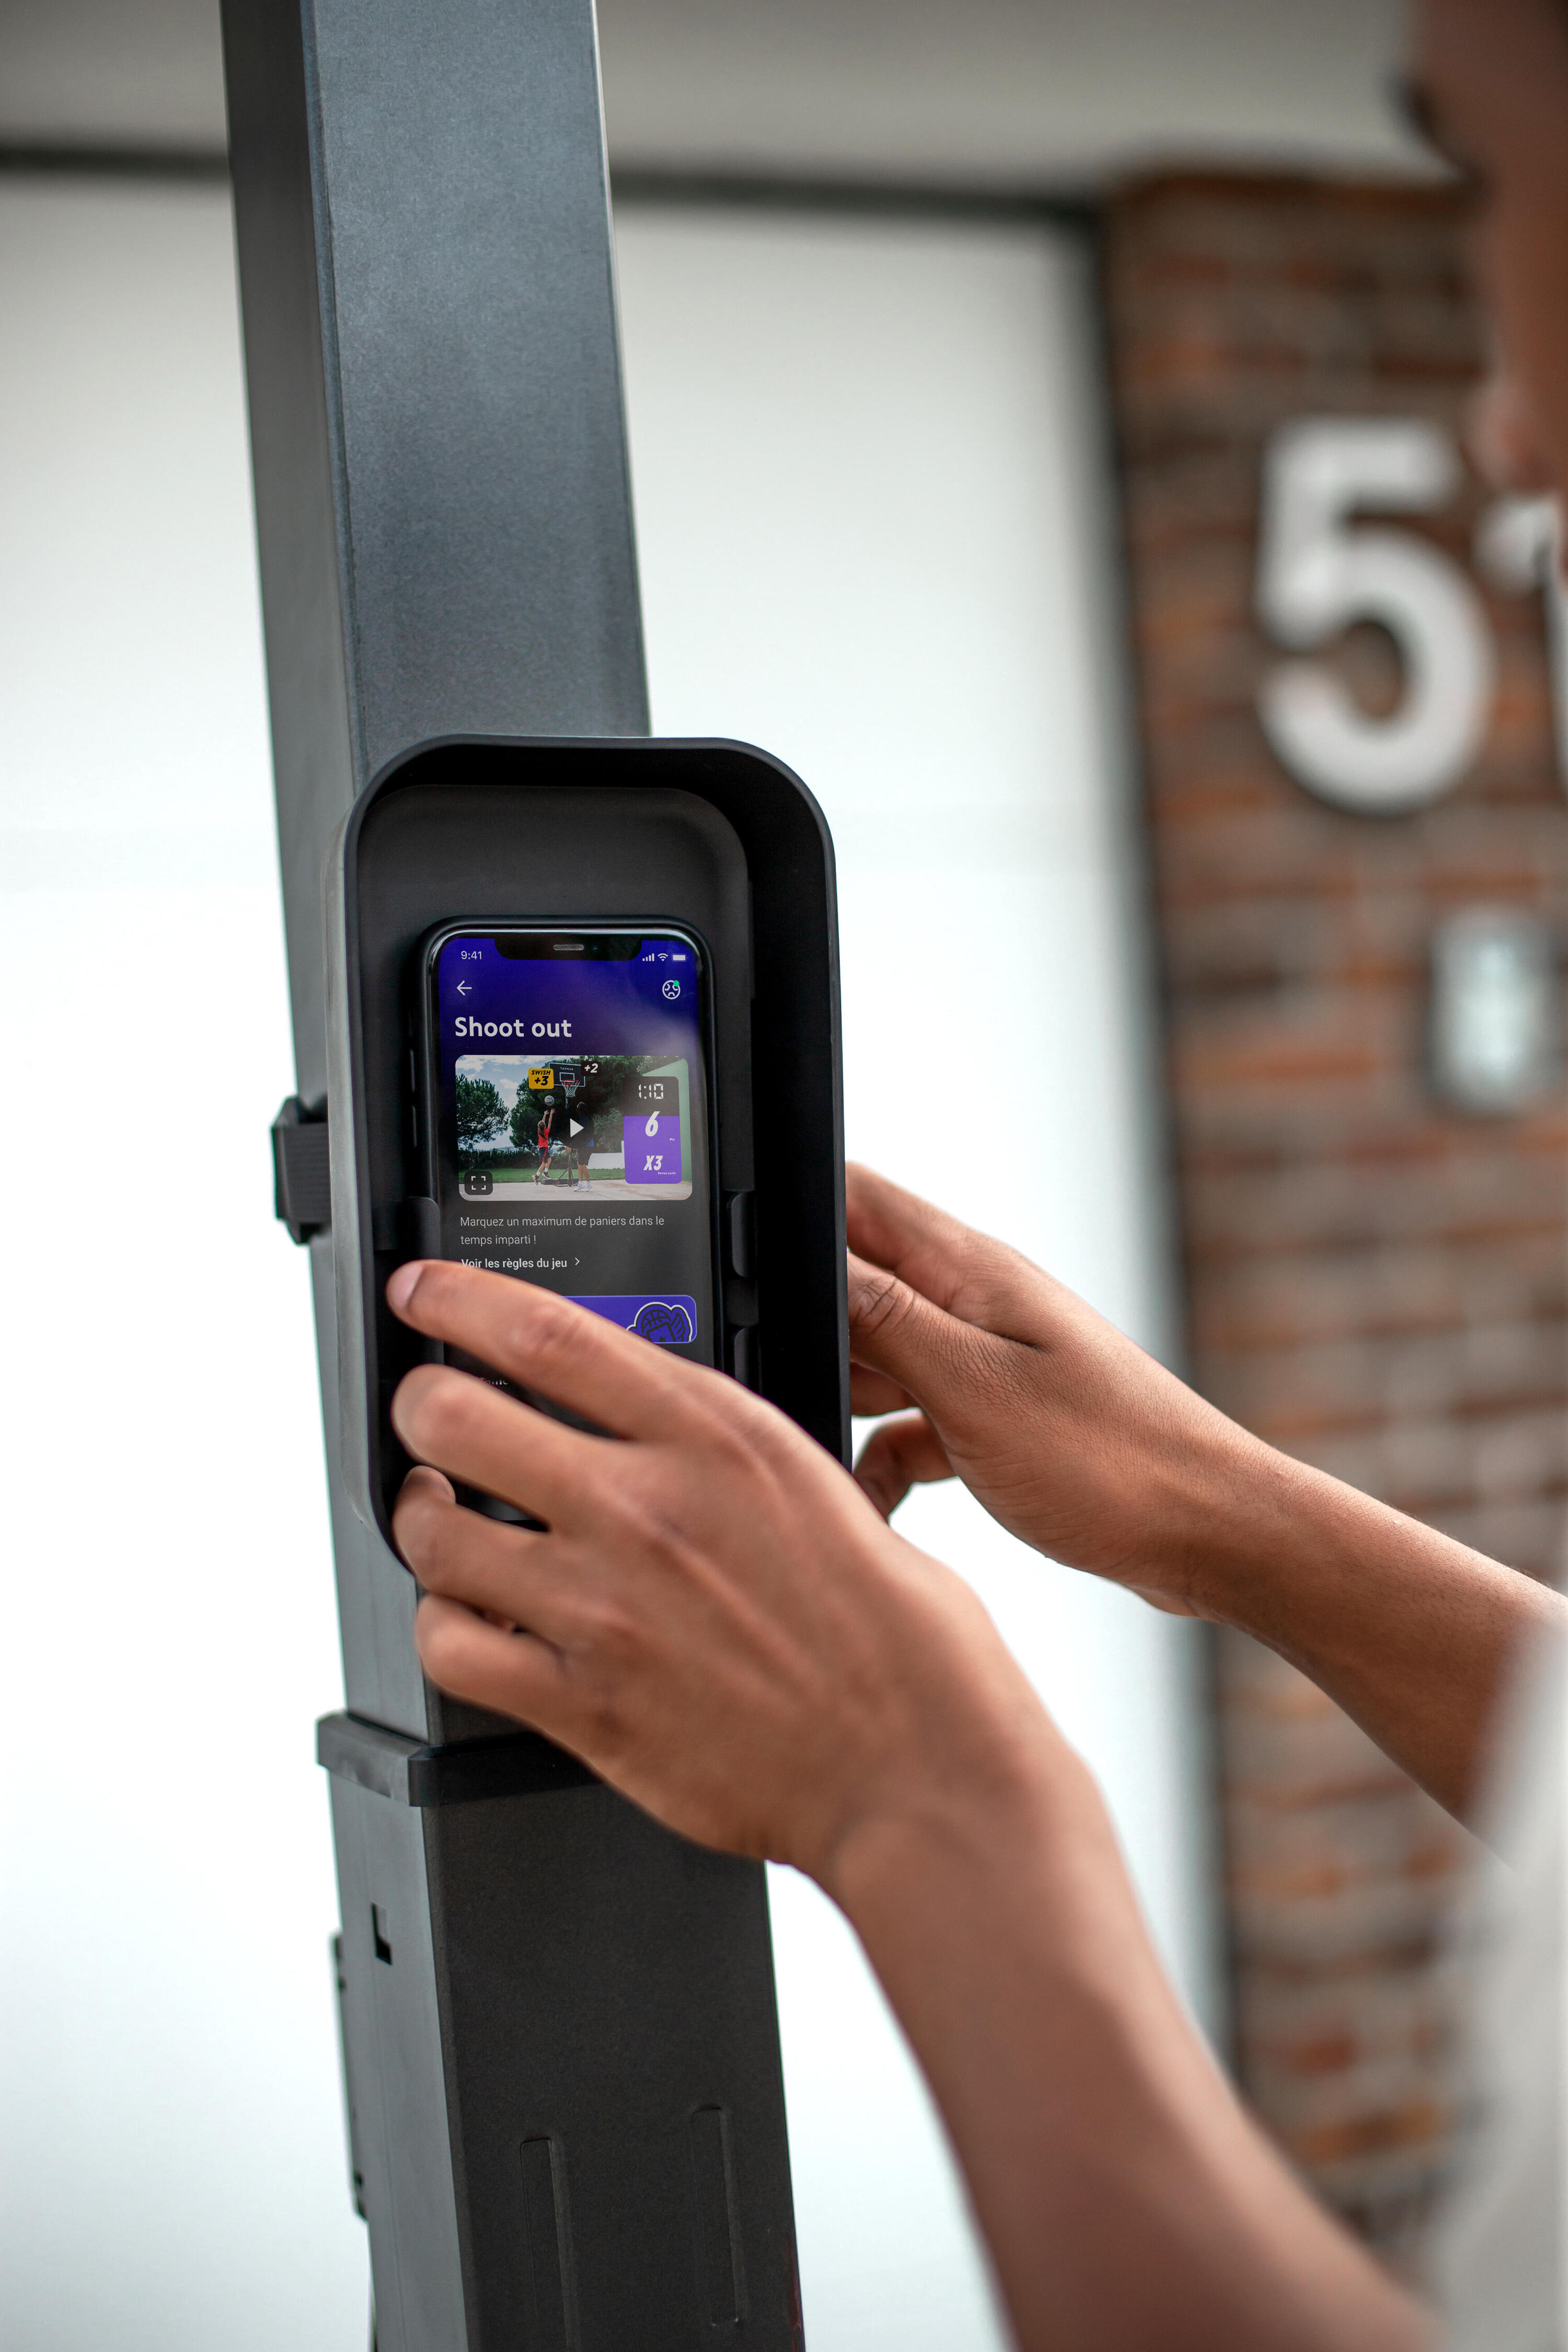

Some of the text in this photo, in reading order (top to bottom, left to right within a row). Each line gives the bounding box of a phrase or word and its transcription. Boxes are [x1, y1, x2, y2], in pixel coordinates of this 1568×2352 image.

[460, 950, 482, 960] 9:41
[455, 1016, 572, 1037] Shoot out
[584, 1063, 598, 1073] +2
[534, 1076, 549, 1086] +3
[638, 1083, 664, 1099] 1:10
[645, 1111, 660, 1137] 6
[643, 1155, 663, 1171] X3
[460, 1217, 504, 1228] Marquez
[523, 1217, 571, 1226] maximum
[575, 1216, 587, 1226] de
[590, 1216, 626, 1228] paniers
[629, 1216, 653, 1226] dans
[655, 1215, 665, 1226] le
[460, 1235, 536, 1246] temps imparti !
[461, 1258, 567, 1270] Voir les règles du jeu
